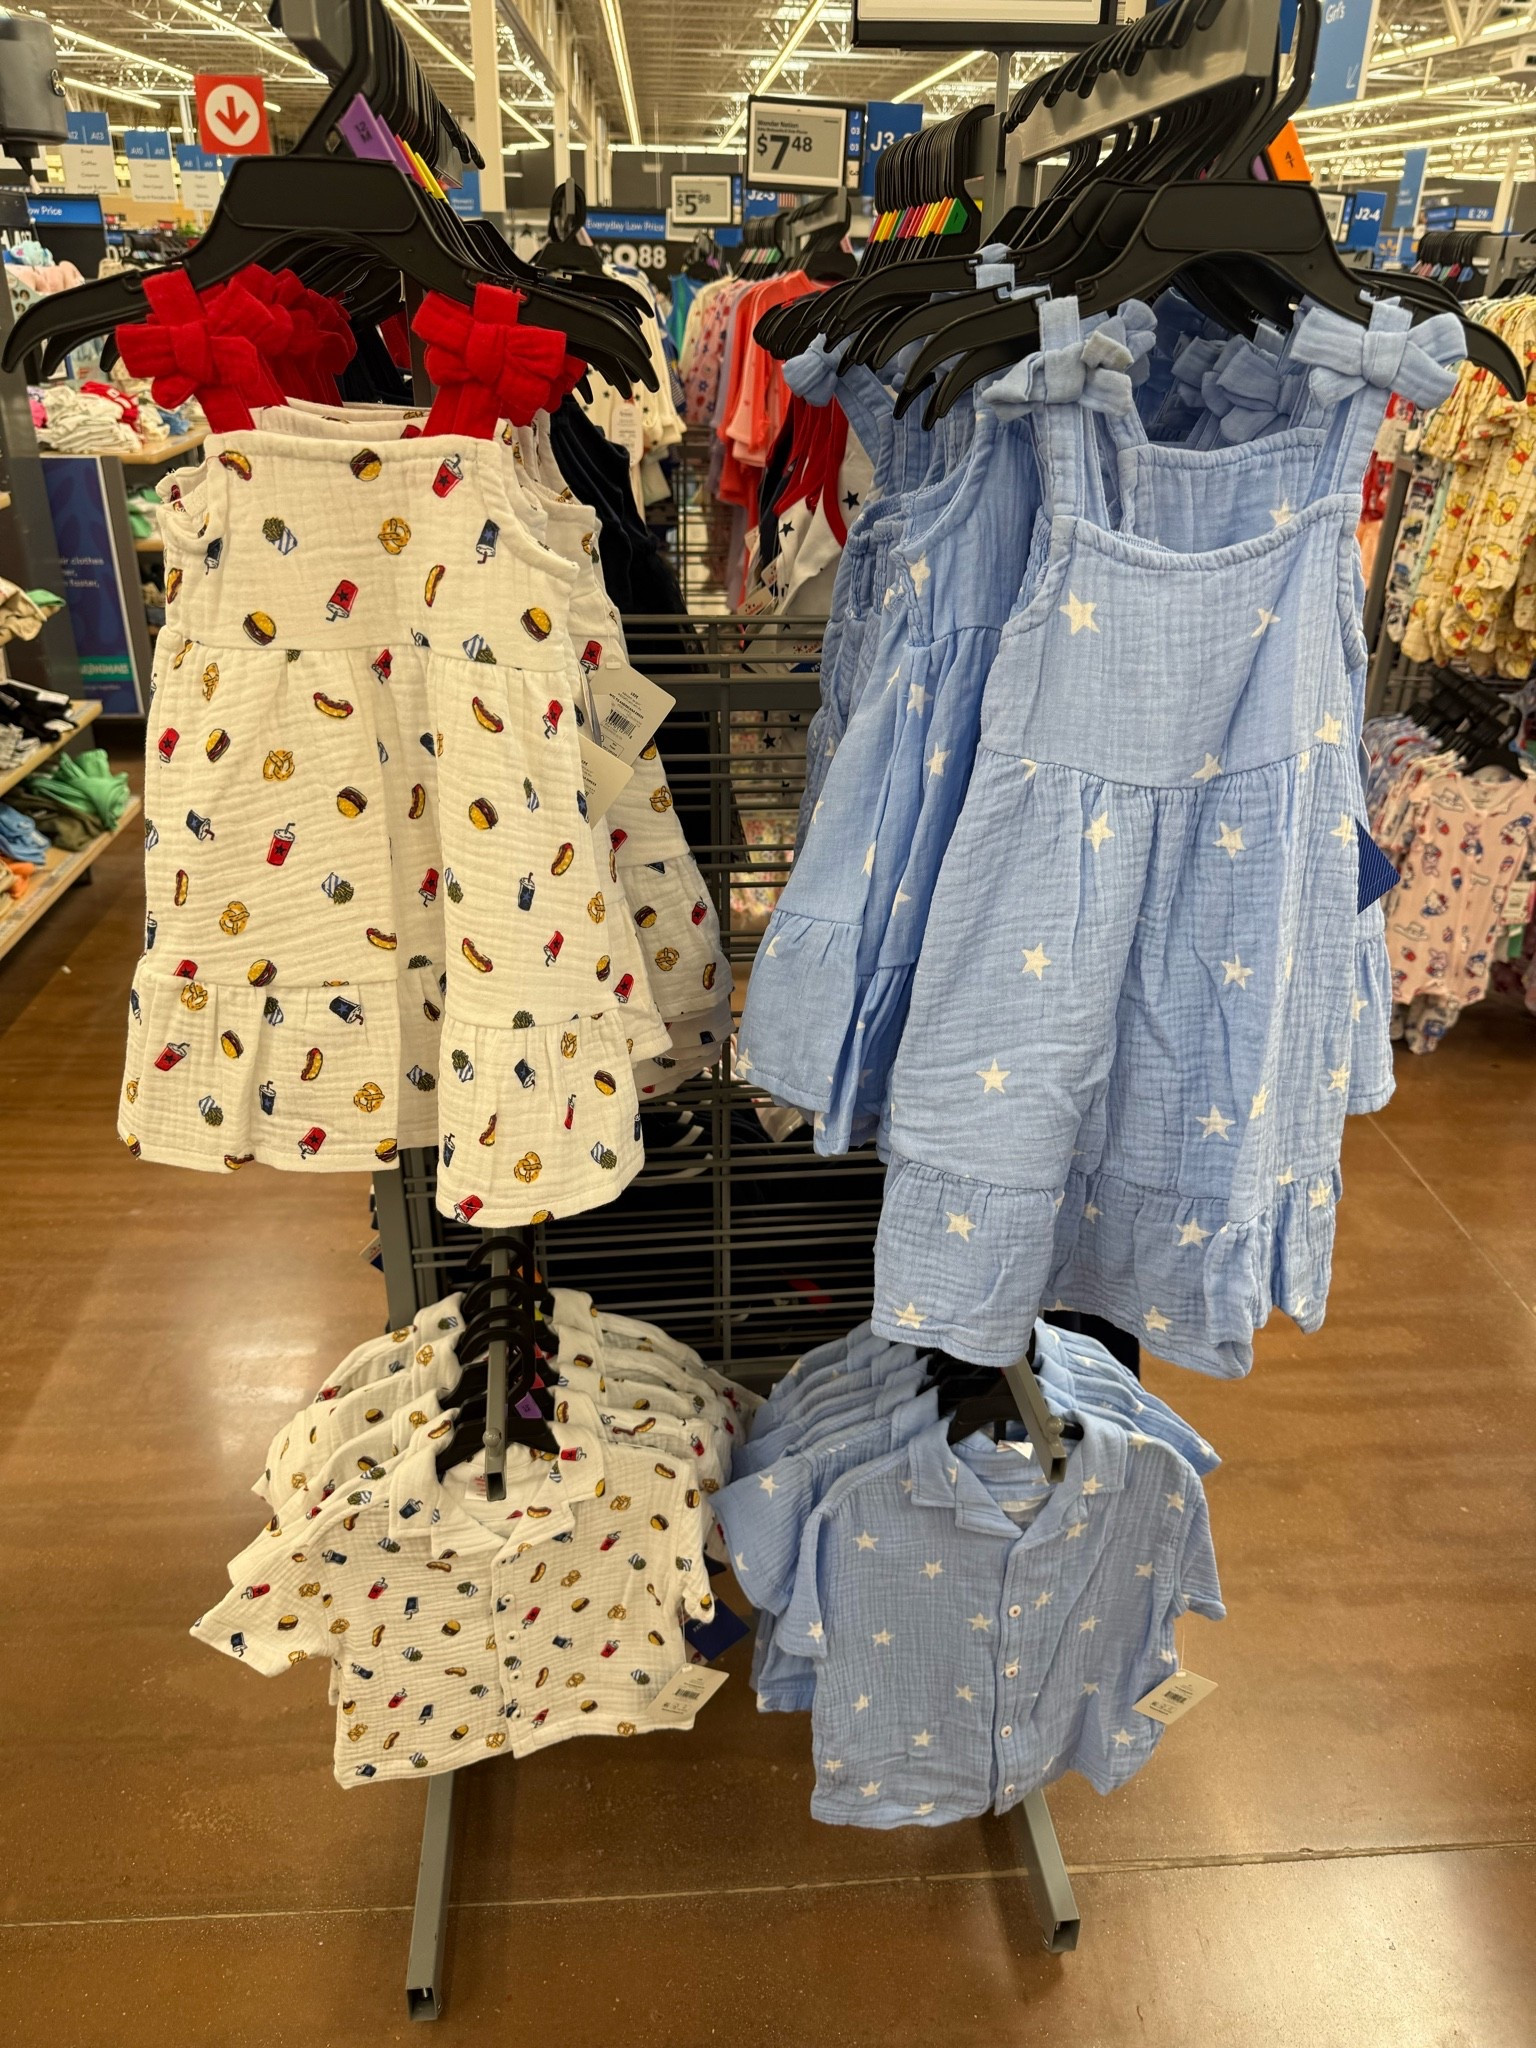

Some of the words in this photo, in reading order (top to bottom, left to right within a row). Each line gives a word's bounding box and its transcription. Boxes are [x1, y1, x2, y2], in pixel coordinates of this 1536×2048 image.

[41, 206, 62, 216] Price
[1355, 207, 1381, 221] J2-4
[586, 218, 625, 231] Everyday
[627, 221, 642, 230] Low
[644, 222, 665, 232] Price
